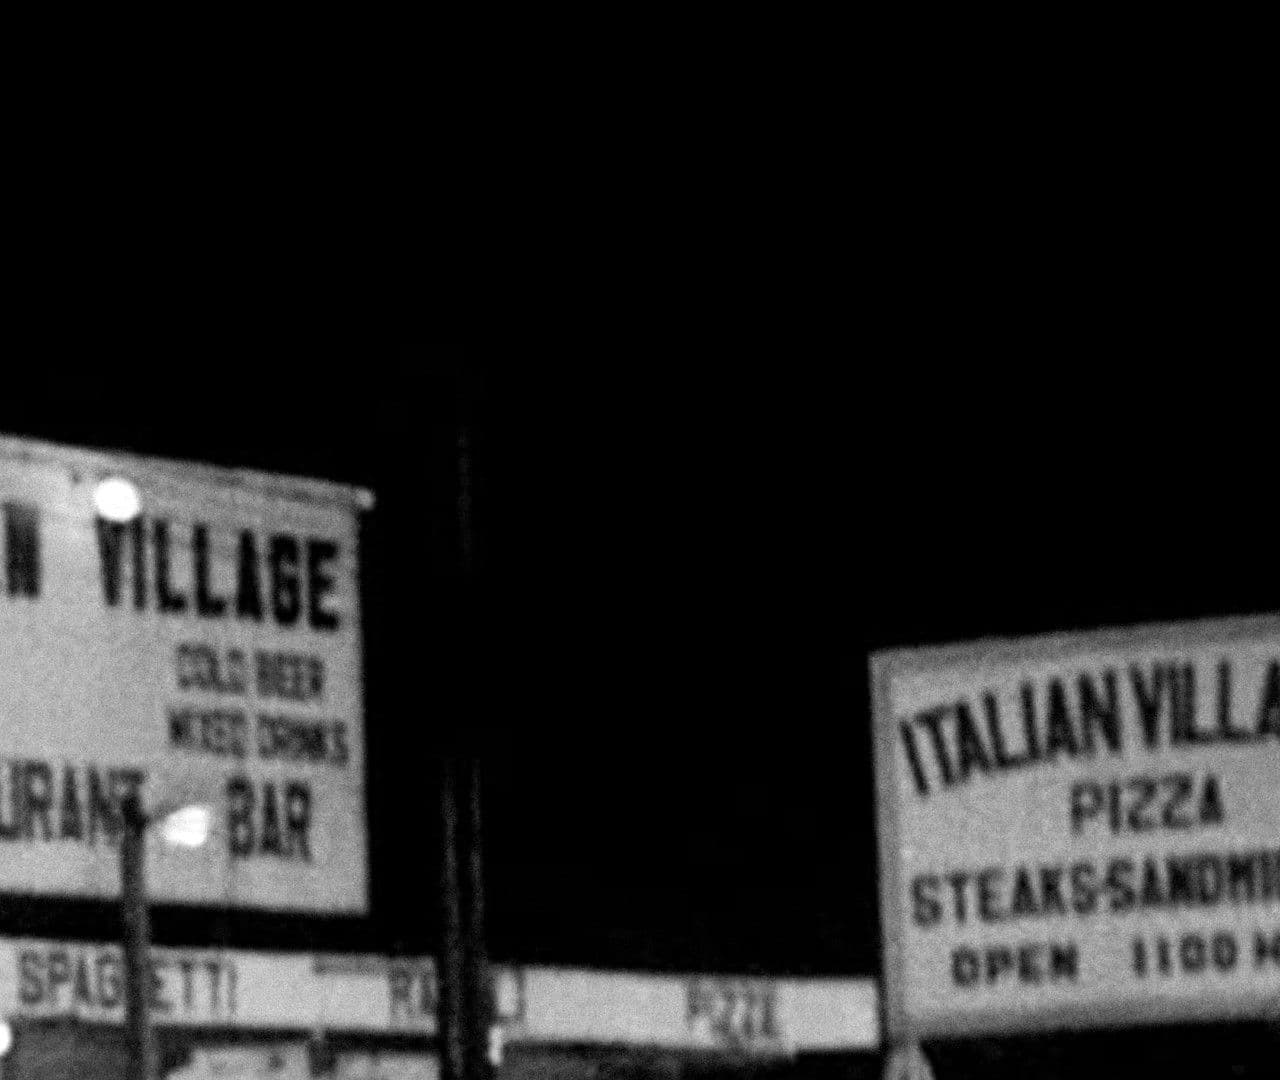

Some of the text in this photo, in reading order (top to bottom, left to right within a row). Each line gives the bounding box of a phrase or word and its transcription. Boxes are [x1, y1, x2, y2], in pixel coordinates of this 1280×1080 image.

[96, 514, 340, 631] VILLAGE
[899, 666, 1122, 796] ITALIAN
[226, 776, 313, 862] BAR
[1070, 772, 1224, 835] PIZZA
[18, 950, 238, 1014] SPAGETTI
[952, 938, 1079, 988] OPEN
